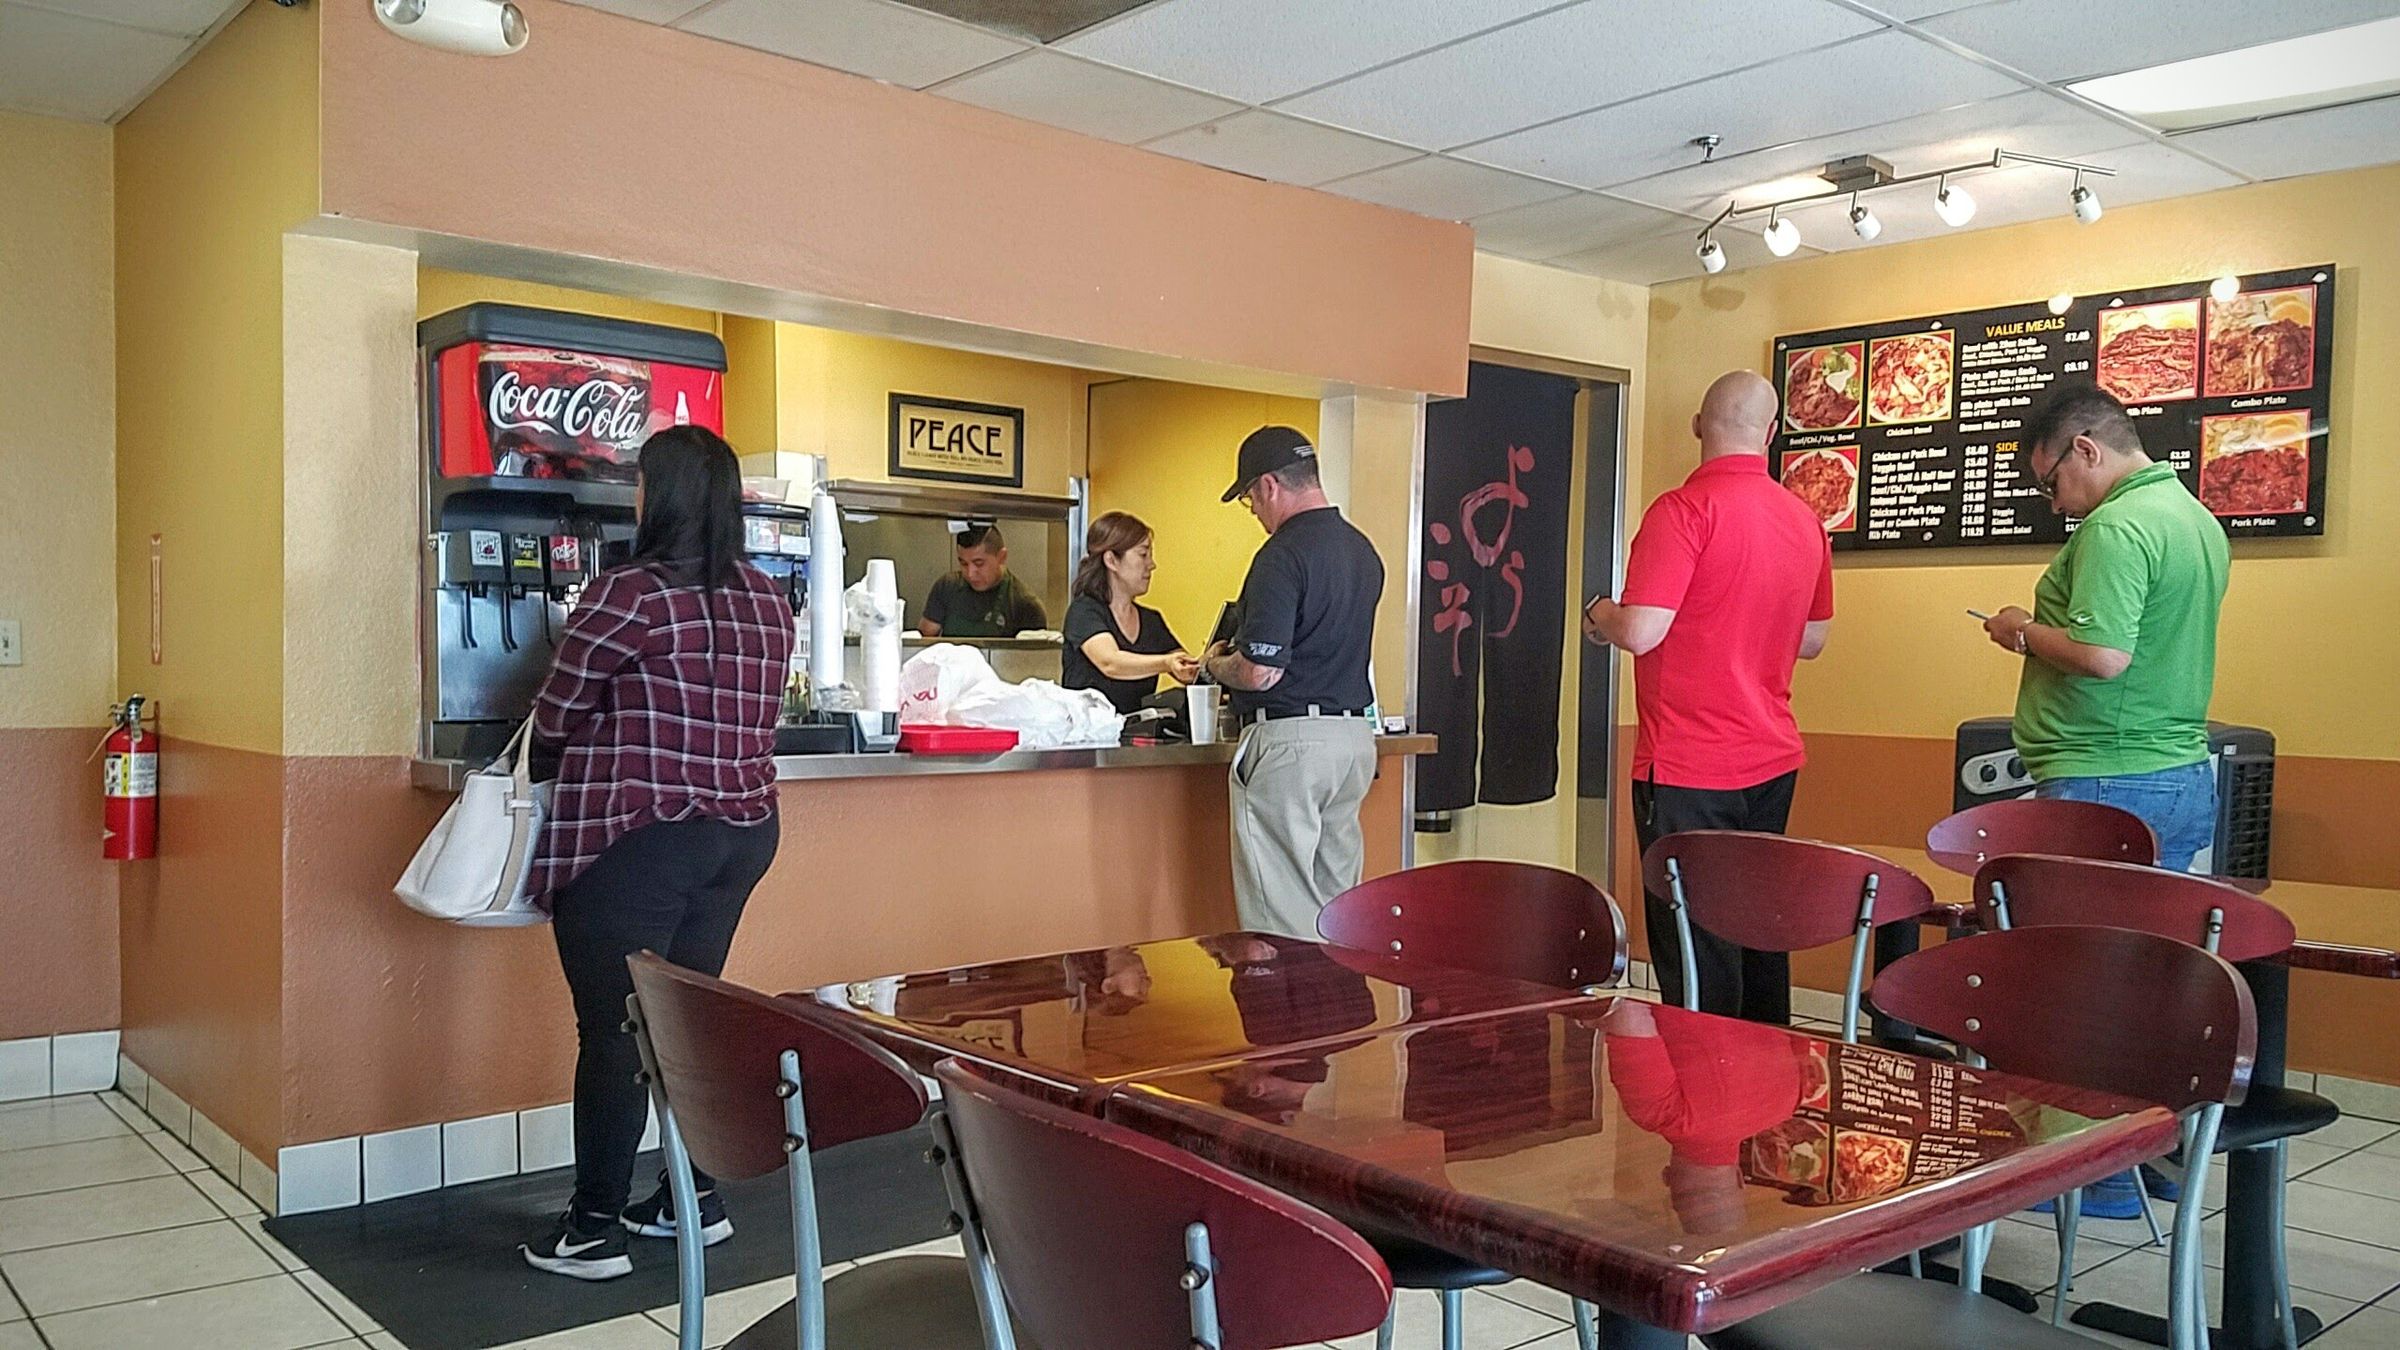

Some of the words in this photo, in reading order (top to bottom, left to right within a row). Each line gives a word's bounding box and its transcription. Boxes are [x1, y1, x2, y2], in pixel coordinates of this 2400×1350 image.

[1986, 323, 2024, 337] VALUE
[2025, 317, 2066, 333] MEALS
[2231, 398, 2263, 409] Combo
[2263, 396, 2288, 406] Plate
[2141, 406, 2163, 416] Plate
[909, 417, 1003, 458] PEACE
[1996, 442, 2019, 452] SIDE
[1872, 452, 1901, 462] Chicken
[1911, 449, 1928, 459] Pork
[1872, 463, 1896, 474] Veggie
[1870, 507, 1898, 518] Chicken
[1908, 506, 1925, 516] Pork
[1926, 504, 1946, 515] Plate
[1921, 516, 1940, 526] Plate
[2231, 518, 2252, 527] Pork
[2253, 517, 2277, 526] Plate
[1882, 529, 1901, 539] Plate
